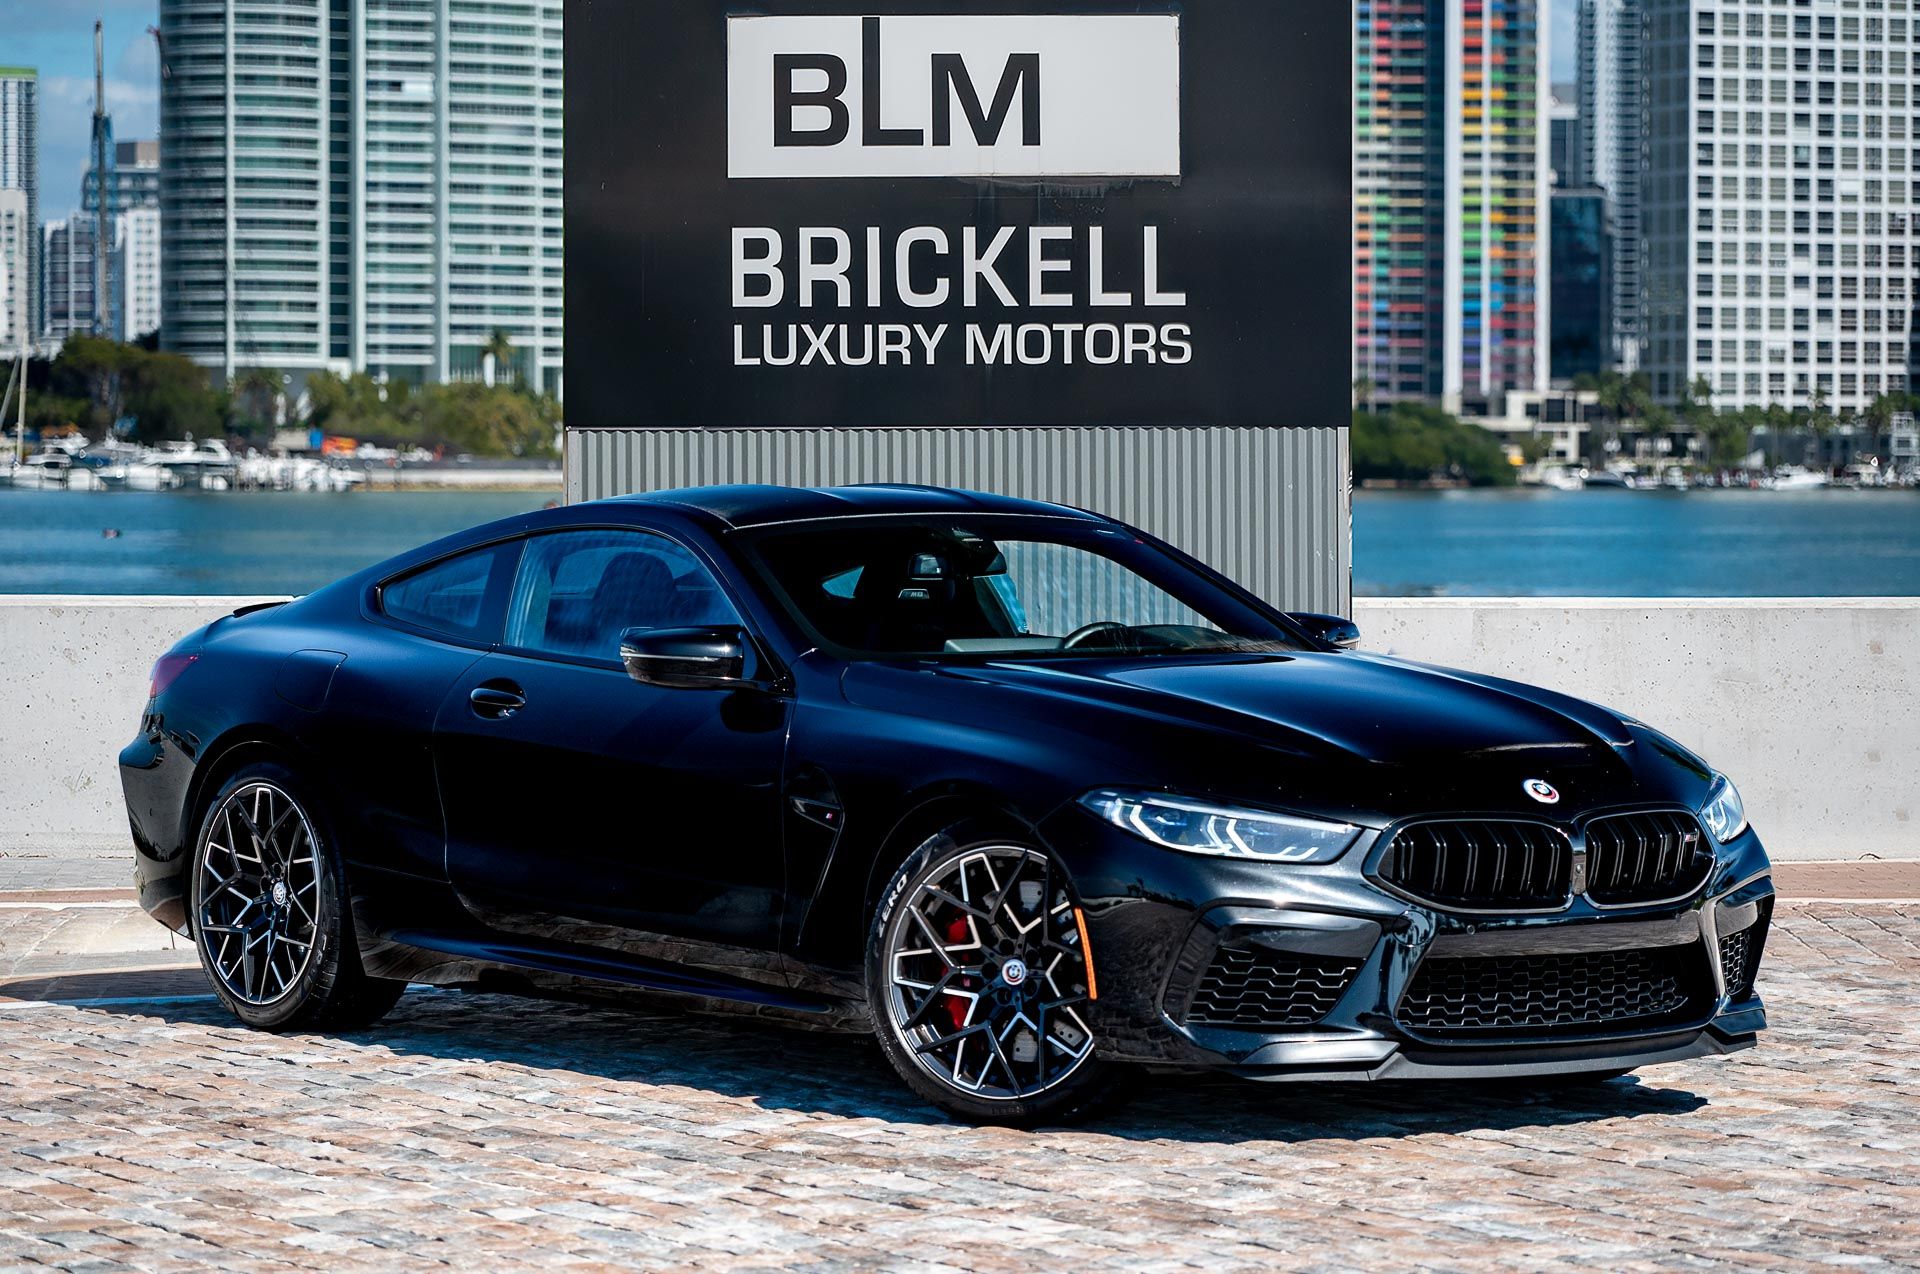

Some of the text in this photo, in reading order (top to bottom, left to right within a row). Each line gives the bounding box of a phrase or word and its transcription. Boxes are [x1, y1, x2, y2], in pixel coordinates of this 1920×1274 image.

[773, 17, 1041, 147] BLM
[731, 226, 1187, 307] BRICKELL
[733, 323, 1192, 365] LUXURY MOTORS
[878, 874, 907, 938] ZERO
